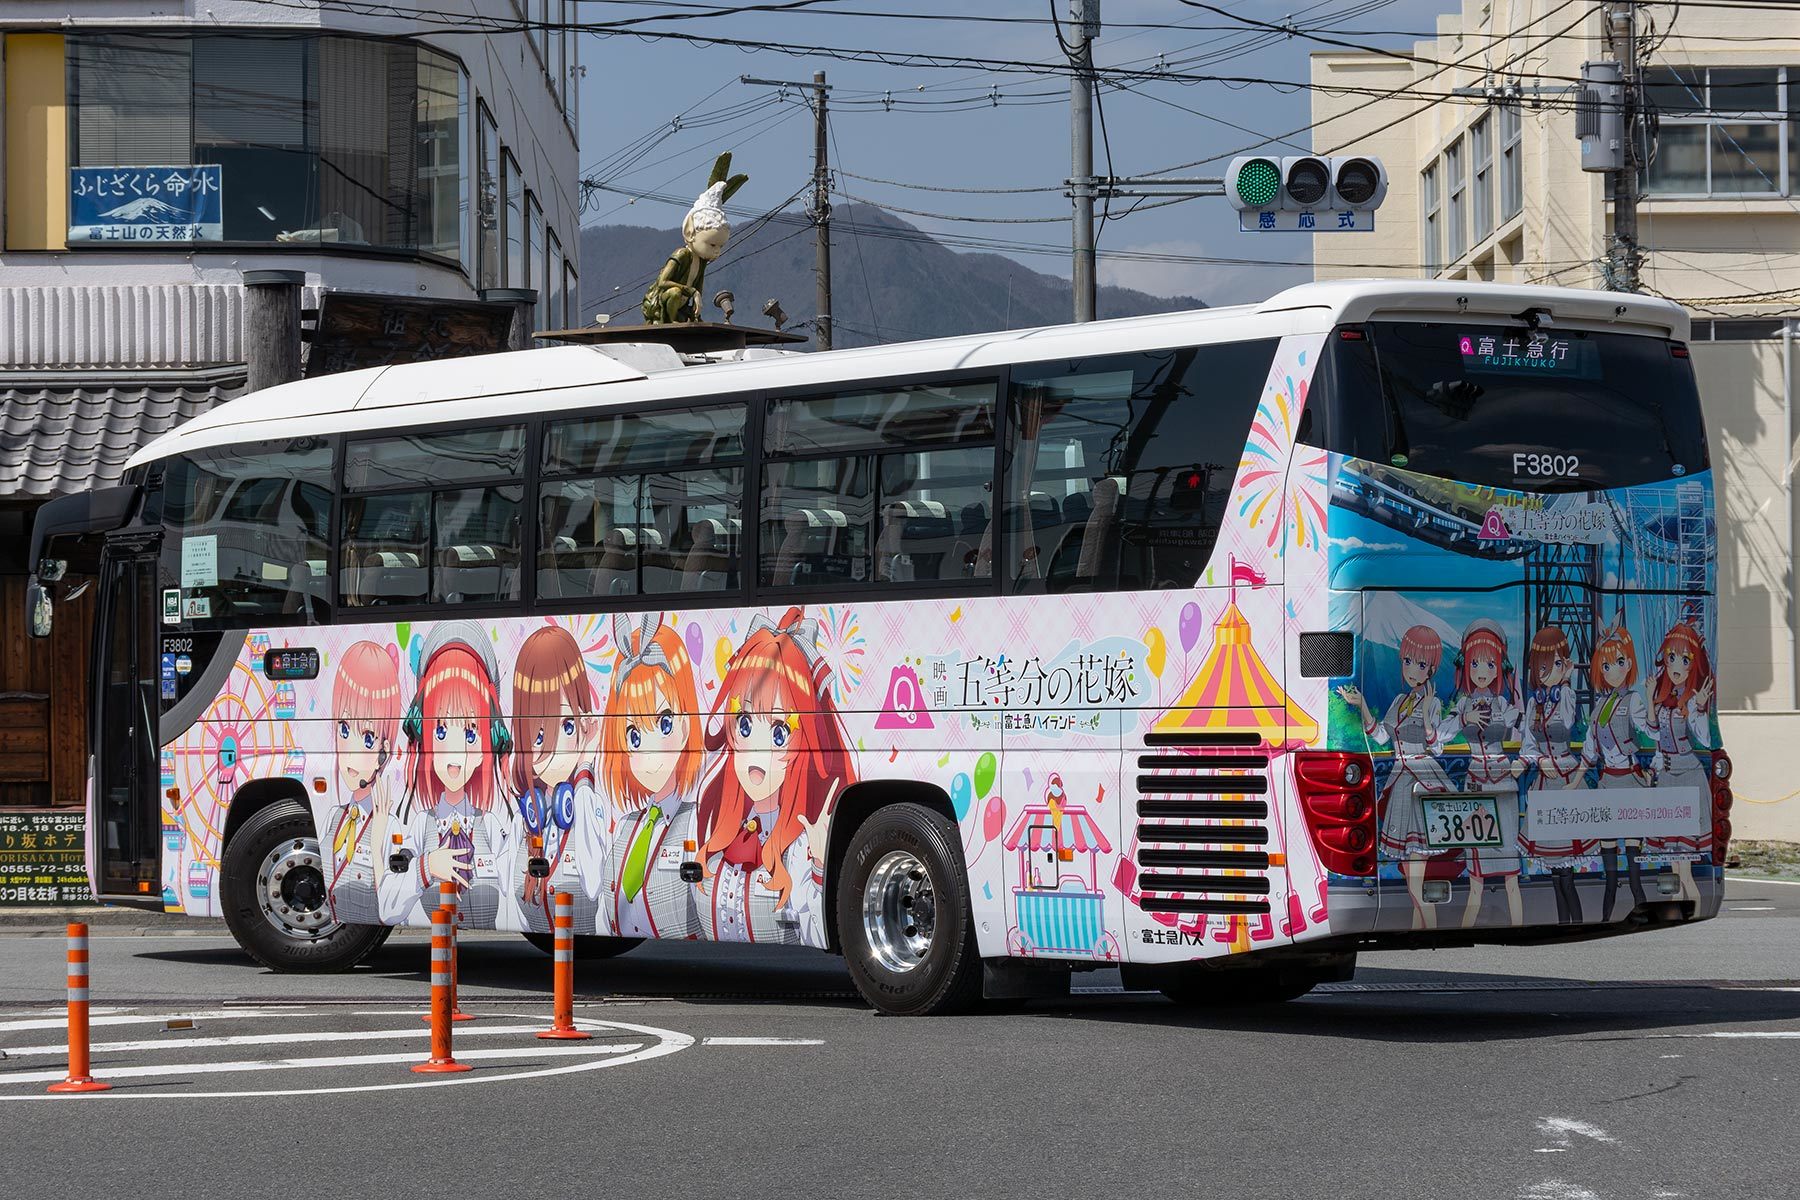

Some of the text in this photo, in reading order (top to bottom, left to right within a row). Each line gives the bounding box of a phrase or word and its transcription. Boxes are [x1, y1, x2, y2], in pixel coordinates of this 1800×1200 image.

[73, 171, 219, 197] ふじざくら命水
[1258, 210, 1355, 229] 感応式
[89, 225, 204, 241] 富士山の天然水
[1478, 337, 1569, 360] 富士急行
[1484, 356, 1556, 369] FUJIKYUKO
[1513, 453, 1580, 477] F3802
[1521, 508, 1607, 531] 五等分の花嫁
[163, 638, 193, 653] F3802
[282, 652, 317, 670] 富士急行
[932, 660, 948, 708] 映画
[953, 654, 1140, 707] 五等分の花嫁
[893, 676, 917, 724] Q
[1004, 713, 1077, 730] 富士急ハイランド
[1438, 802, 1480, 812] 富士山 210
[1545, 805, 1692, 826] 五等分の花嫁 2022年5月20日公開
[0, 815, 86, 824] に近い 壮大な富士山ビ
[0, 824, 49, 832] 18.4.18
[1430, 814, 1498, 842] あ 38-02
[6, 833, 77, 849] り坂ホテ
[60, 854, 86, 863] HOT
[0, 886, 58, 901] 3つ目を左折
